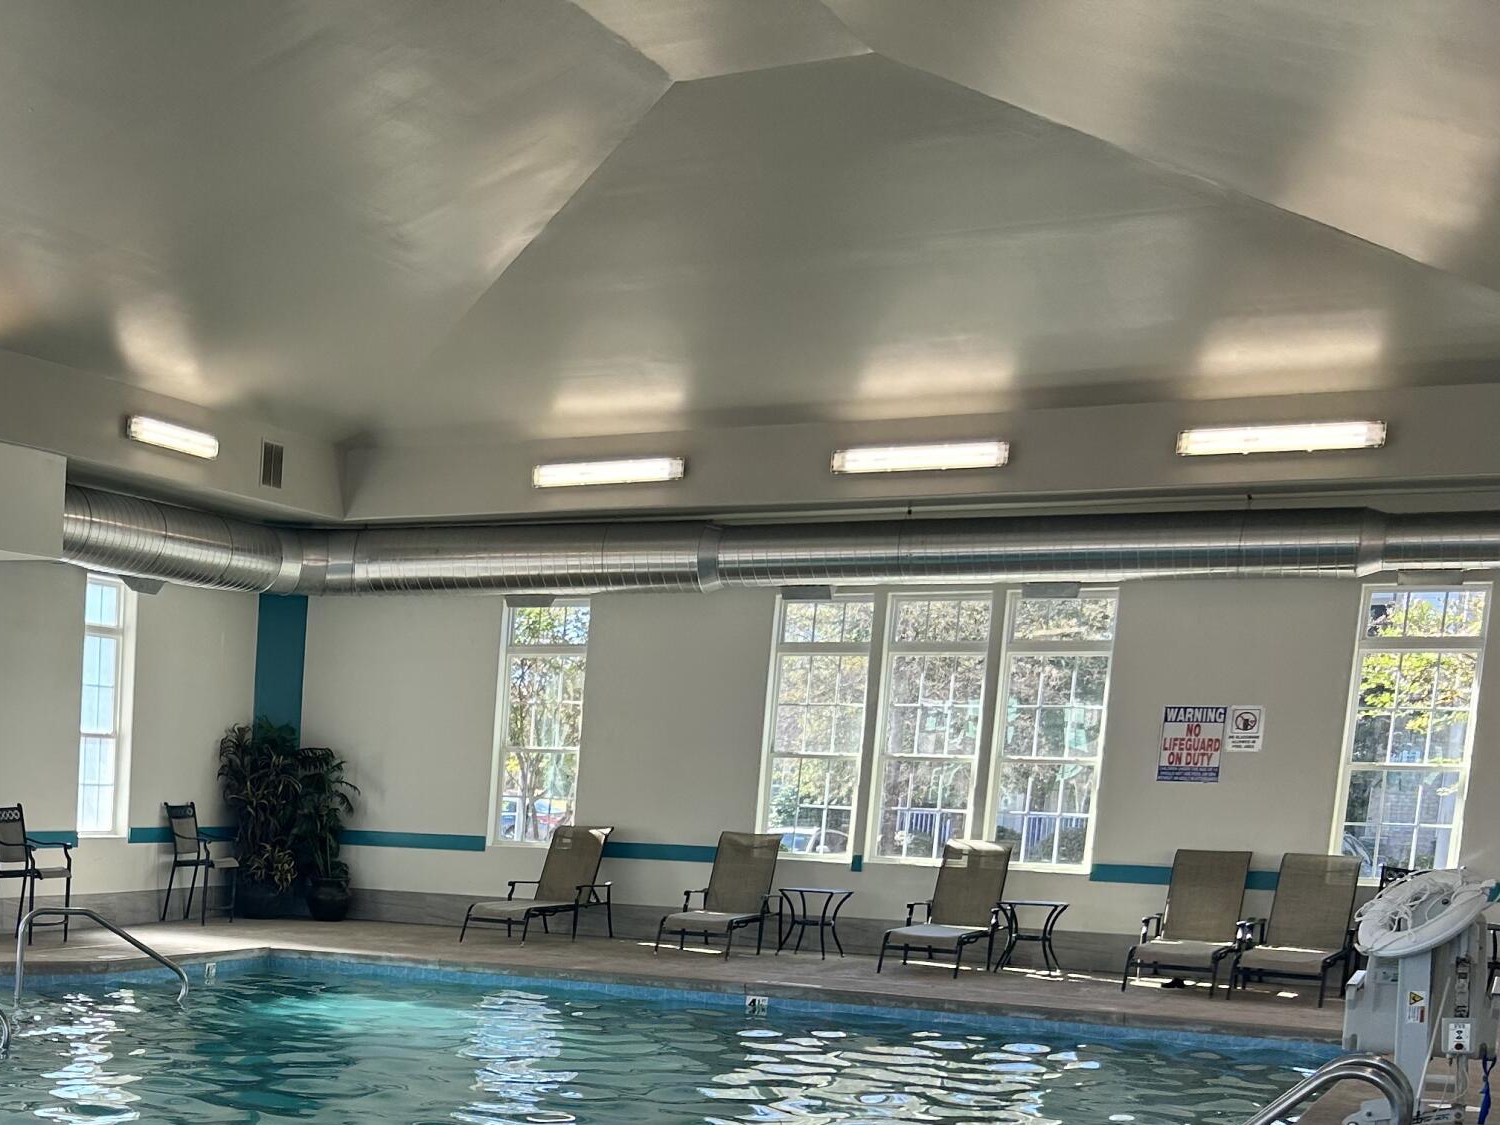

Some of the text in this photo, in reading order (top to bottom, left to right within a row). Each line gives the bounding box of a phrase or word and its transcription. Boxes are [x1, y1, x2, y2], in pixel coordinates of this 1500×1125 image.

[1167, 707, 1225, 722] WARNING
[1186, 723, 1201, 737] NO
[1162, 738, 1221, 752] LIFEGUARD
[1167, 752, 1213, 766] ON DUTY
